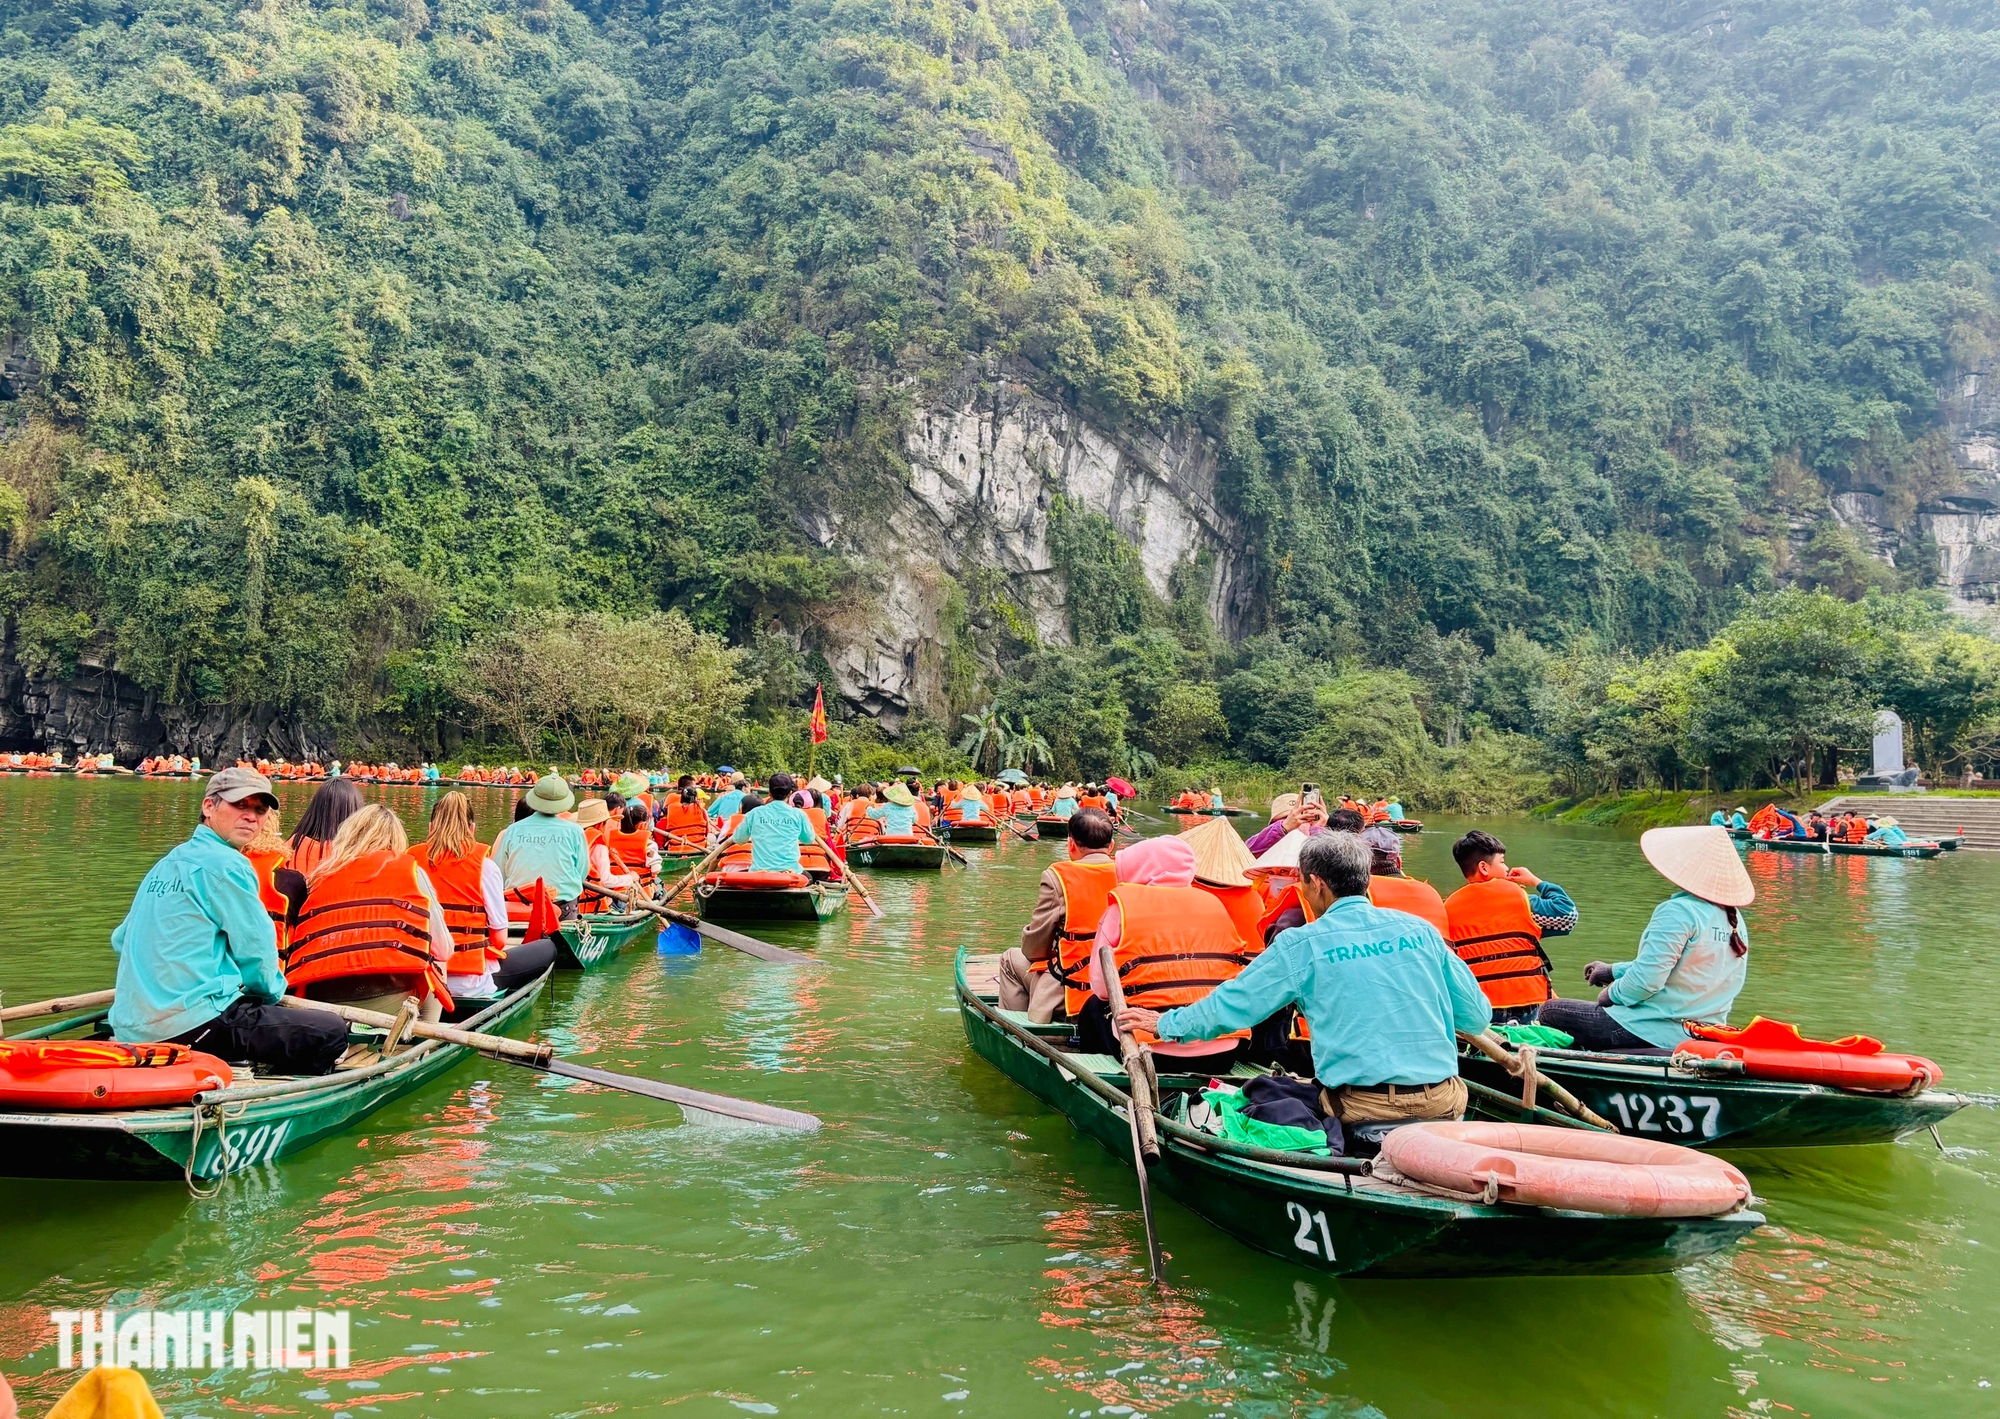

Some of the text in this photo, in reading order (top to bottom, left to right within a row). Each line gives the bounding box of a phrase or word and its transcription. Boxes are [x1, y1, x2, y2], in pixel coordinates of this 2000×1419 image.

[517, 834, 565, 846] Tràng An
[860, 851, 873, 864] 145
[1902, 849, 1921, 857] 1381
[1323, 936, 1424, 964] TRÀNG AN
[1608, 1092, 1720, 1138] 1237
[1286, 1201, 1337, 1261] 21
